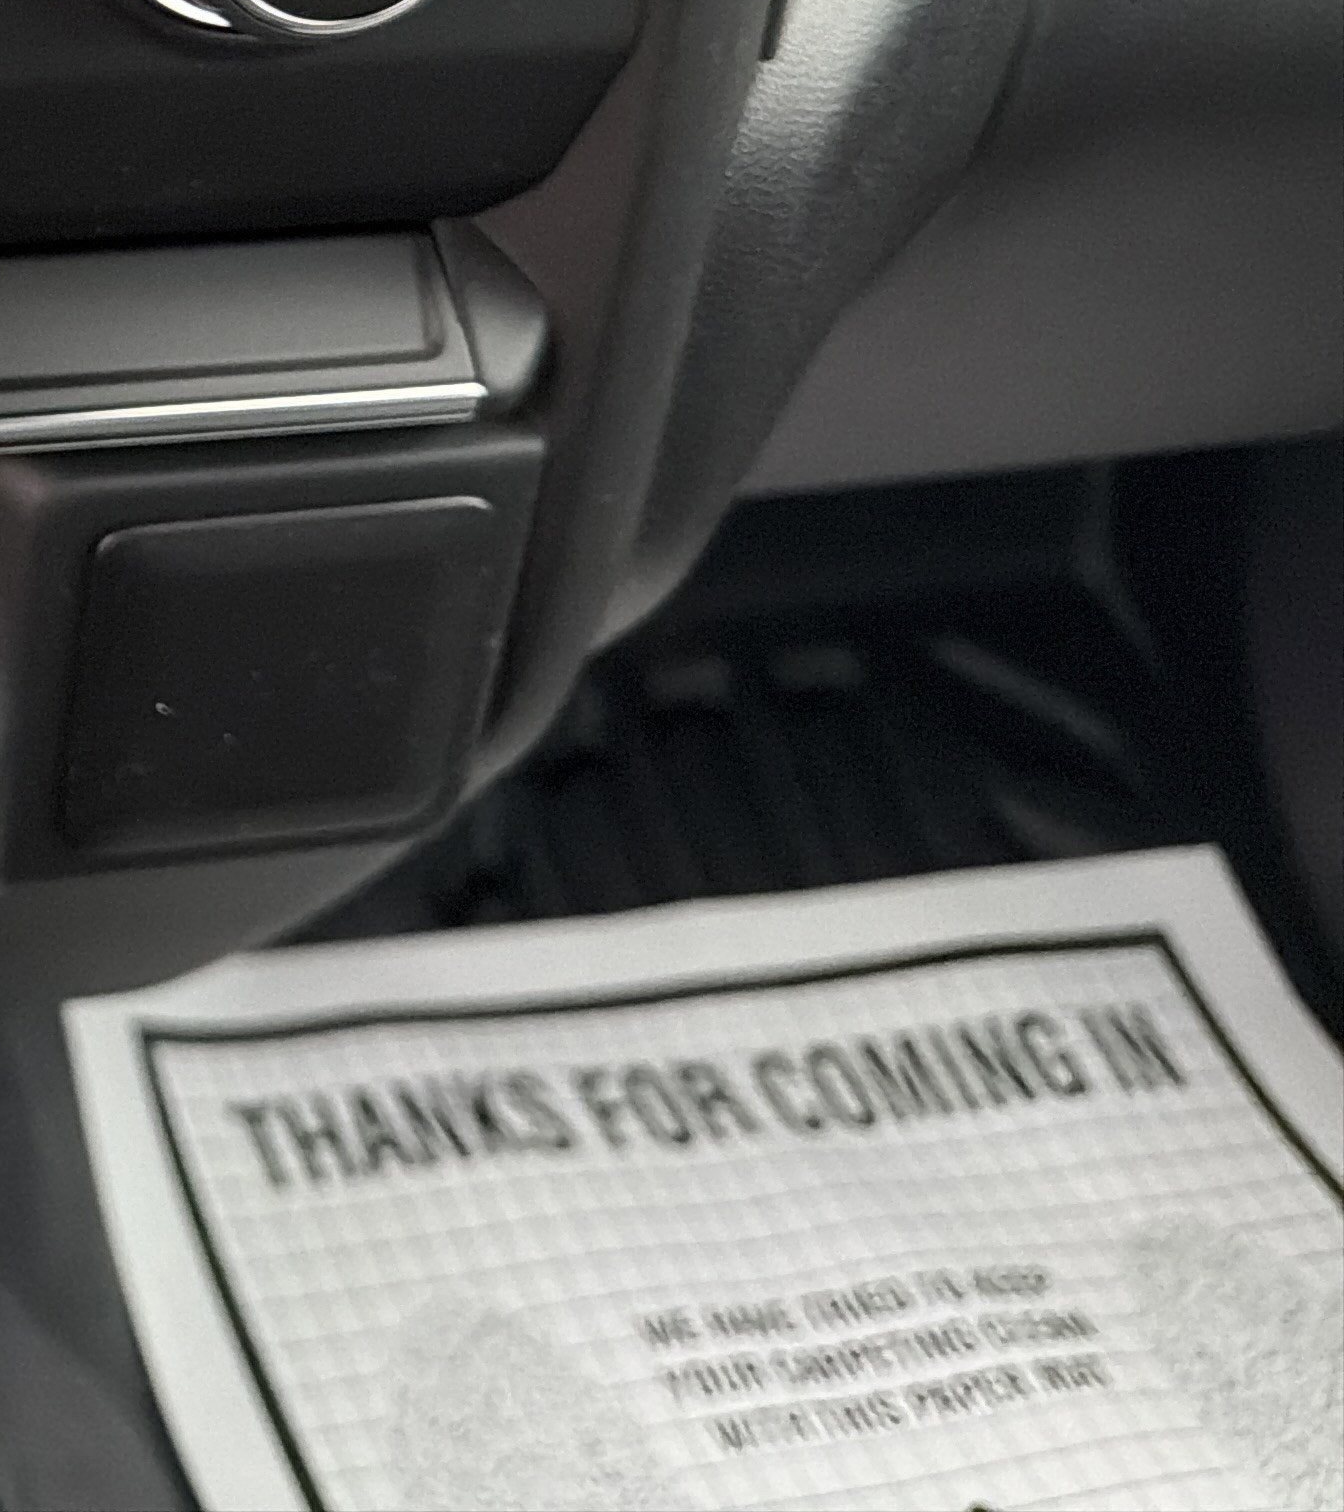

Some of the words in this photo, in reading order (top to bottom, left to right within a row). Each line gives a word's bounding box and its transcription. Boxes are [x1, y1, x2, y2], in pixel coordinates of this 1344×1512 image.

[223, 1067, 574, 1190] THANKS
[570, 1051, 764, 1150] FOR
[749, 1007, 1092, 1136] COMING
[1078, 999, 1190, 1097] IN
